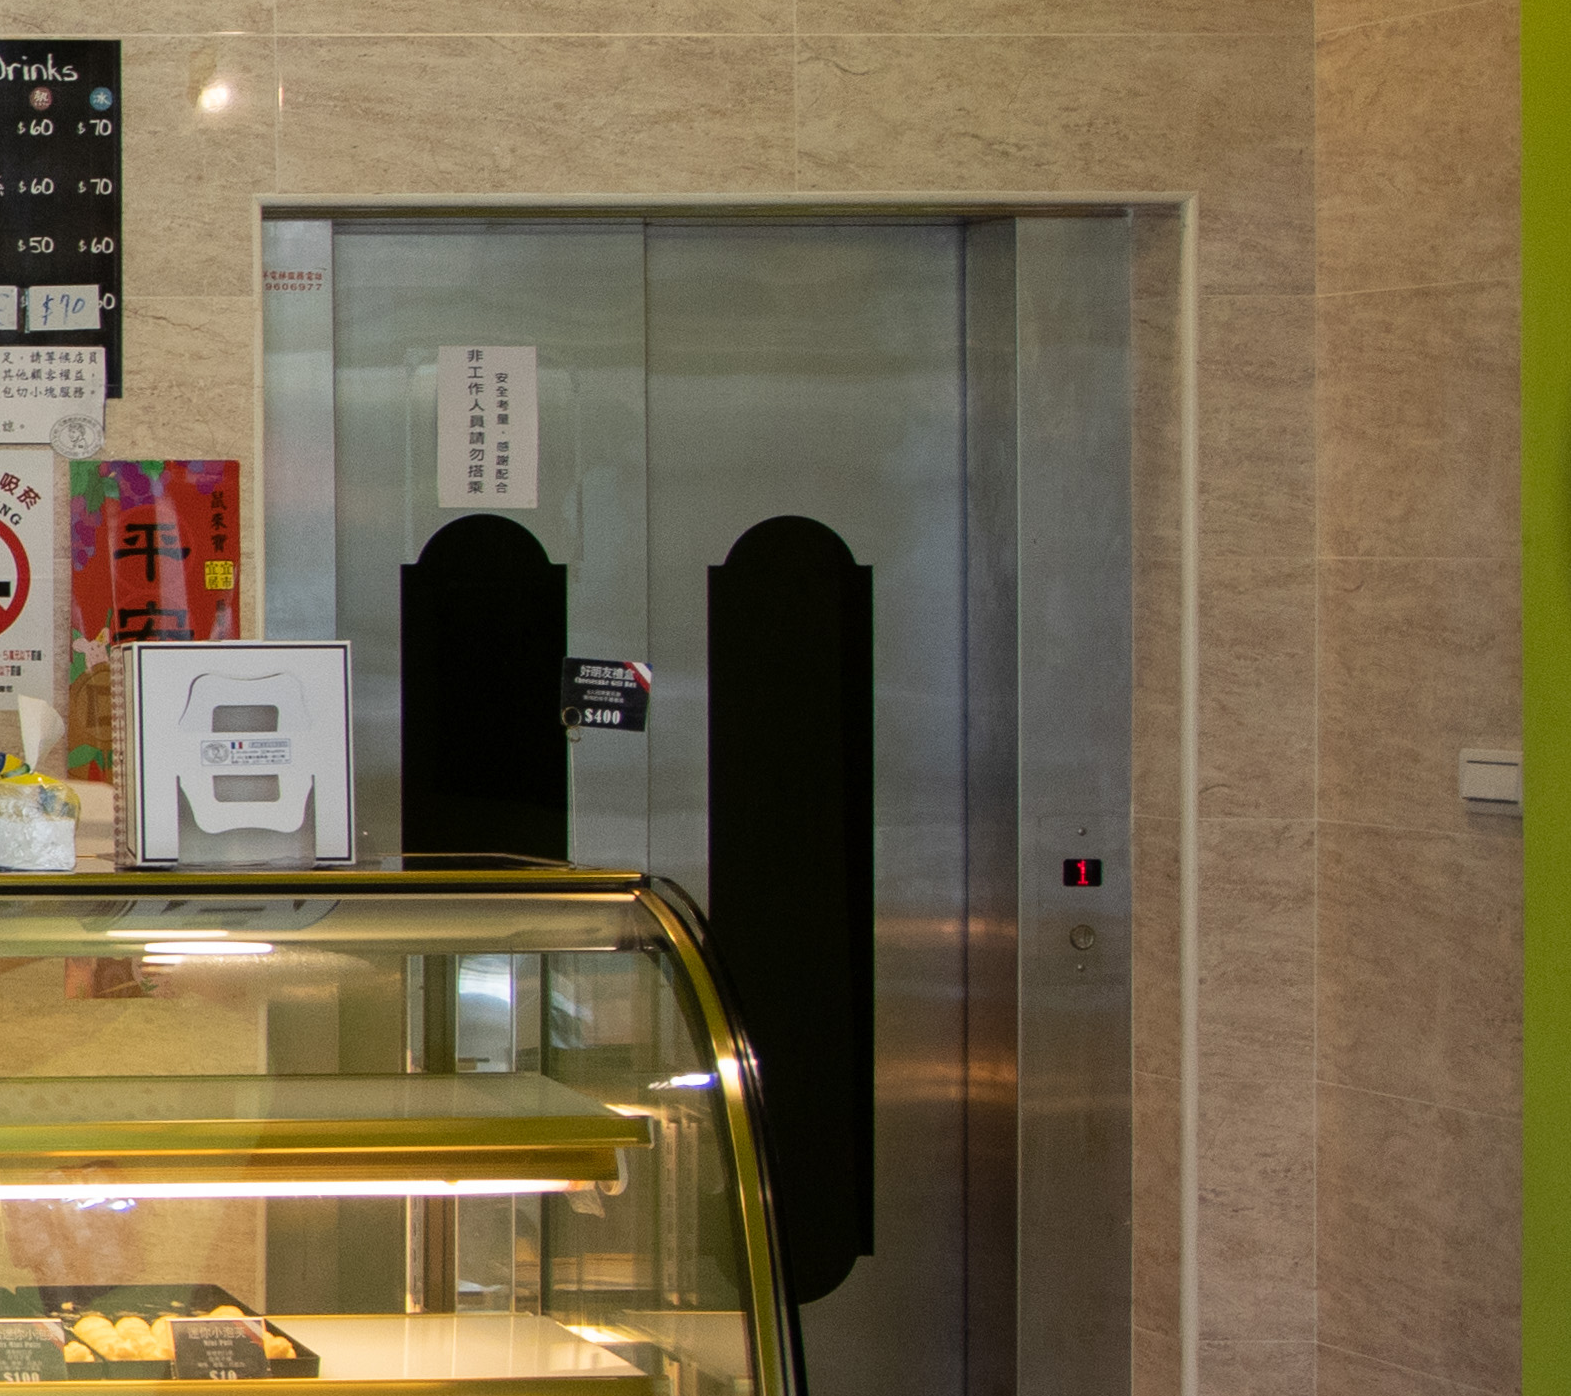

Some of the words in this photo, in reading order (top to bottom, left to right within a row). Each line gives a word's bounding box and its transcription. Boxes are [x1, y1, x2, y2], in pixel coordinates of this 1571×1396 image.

[16, 118, 54, 136] $60
[77, 118, 113, 136] $70
[18, 178, 55, 196] $60
[77, 178, 113, 196] $70
[17, 236, 55, 254] $50
[77, 236, 115, 254] $60
[466, 348, 485, 495] 非工作人員請勿搭乘
[584, 707, 622, 725] $400
[1077, 860, 1089, 886] 1
